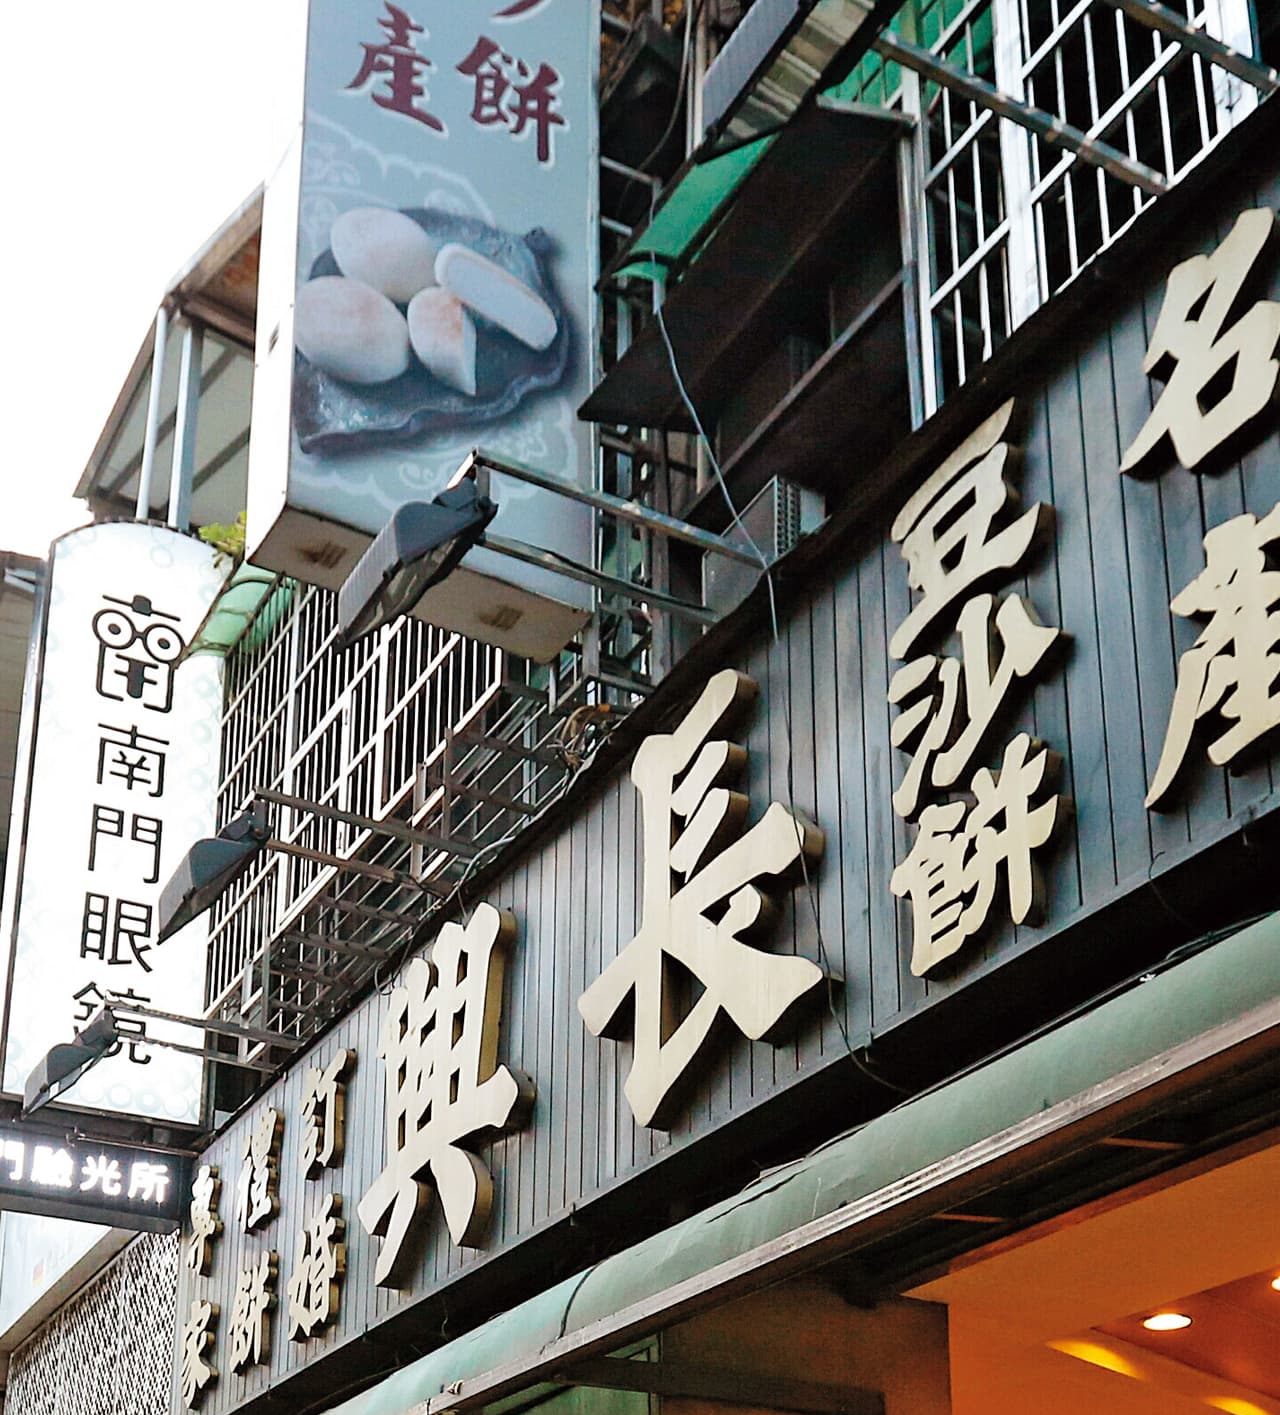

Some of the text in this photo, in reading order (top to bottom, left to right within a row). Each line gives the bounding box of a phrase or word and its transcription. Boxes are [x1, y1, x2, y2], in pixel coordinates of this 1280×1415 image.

[455, 0, 566, 163] 餅
[888, 398, 1059, 978] 豆沙餅
[72, 722, 170, 1066] 南門眼鏡
[287, 1048, 354, 1340] 訂婚
